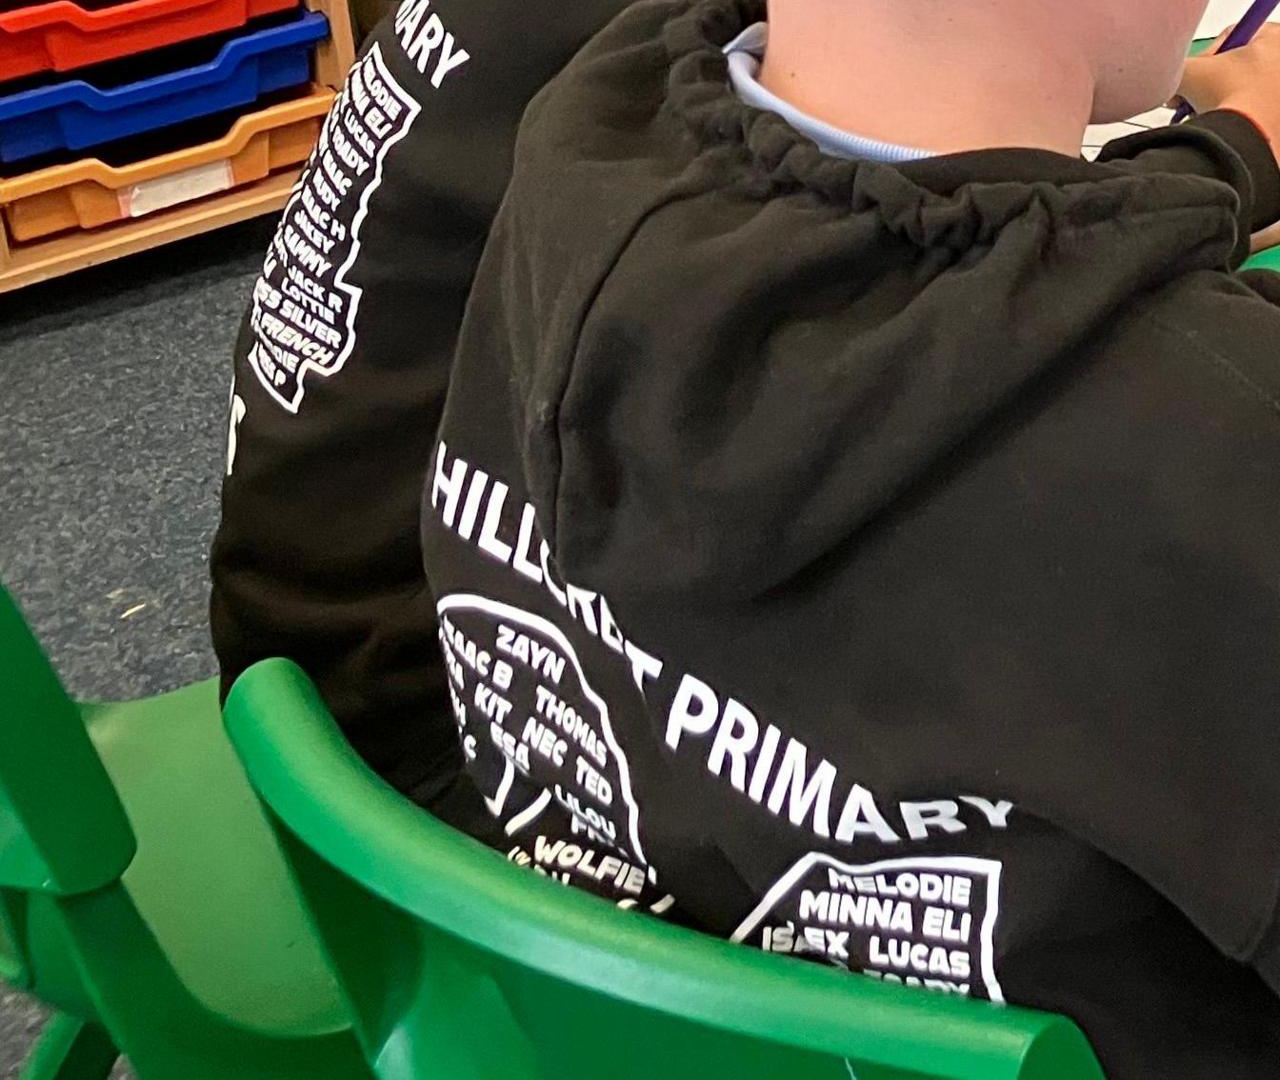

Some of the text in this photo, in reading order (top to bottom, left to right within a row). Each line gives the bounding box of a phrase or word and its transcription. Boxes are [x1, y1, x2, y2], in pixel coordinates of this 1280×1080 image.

[284, 224, 332, 278] SAMMY
[331, 219, 346, 241] H
[281, 277, 335, 325] LOTTIE
[287, 265, 343, 314] JACK R
[260, 312, 335, 366] FRENCH
[279, 299, 342, 349] SILVER
[495, 623, 566, 684] ZAYN
[492, 660, 513, 691] B
[535, 684, 608, 768] THOMAS
[474, 682, 513, 724] KIT
[521, 716, 568, 768] NEC
[575, 755, 613, 807] TED
[665, 673, 1014, 843] PRIMARY
[534, 835, 646, 896] WOLFIE
[828, 867, 972, 907] MELODIE
[799, 889, 972, 944] MINNA ELI
[869, 936, 970, 979] LUCAS
